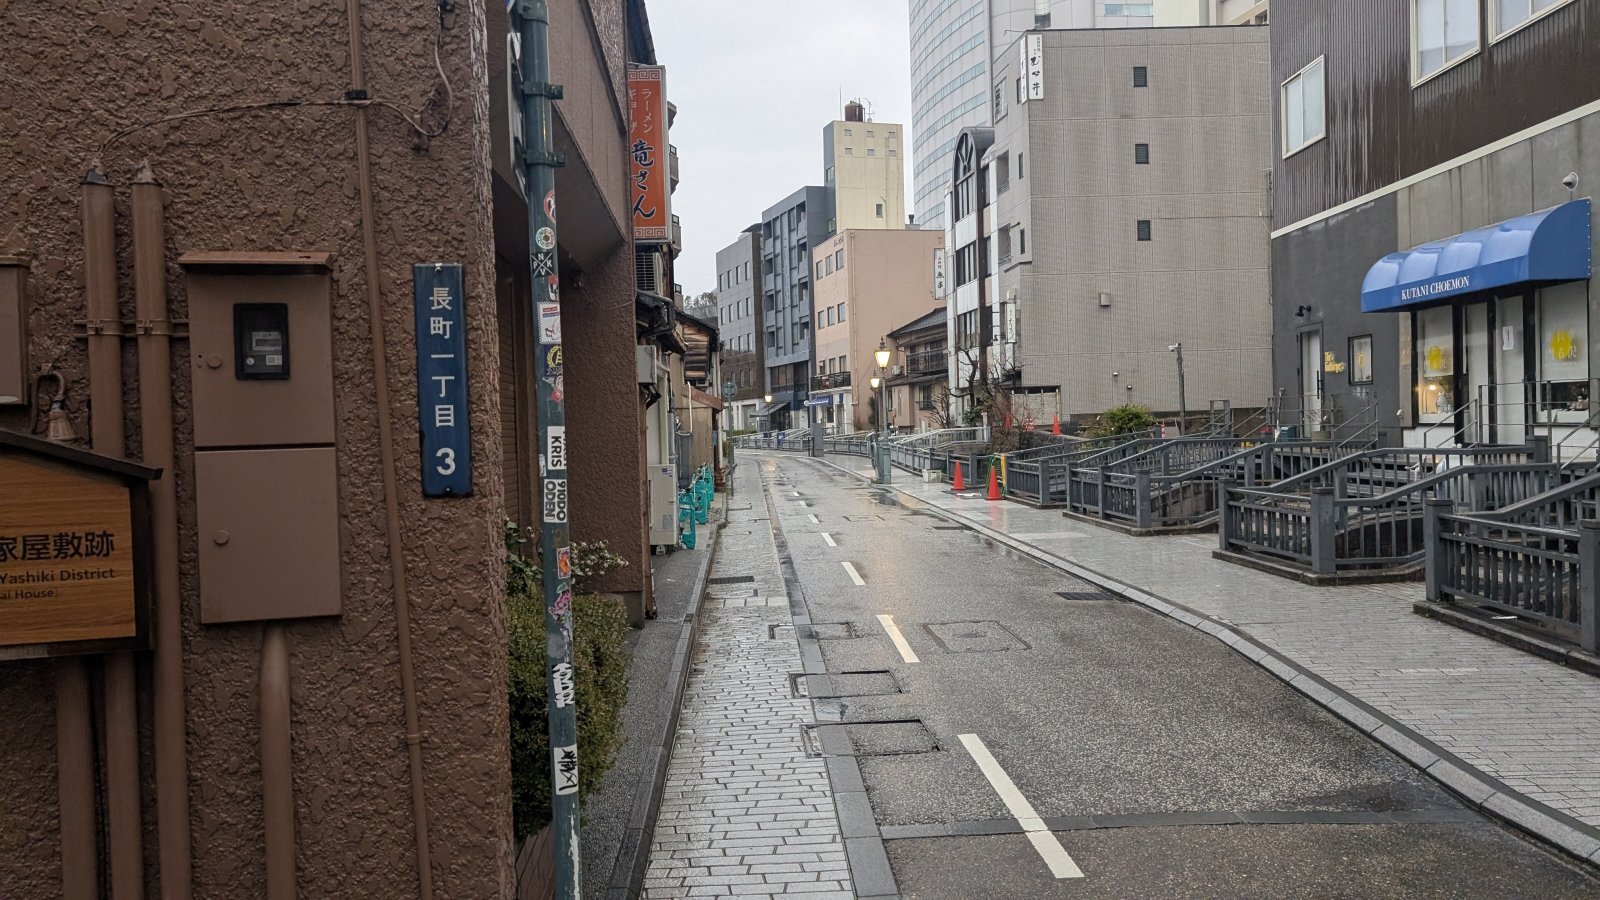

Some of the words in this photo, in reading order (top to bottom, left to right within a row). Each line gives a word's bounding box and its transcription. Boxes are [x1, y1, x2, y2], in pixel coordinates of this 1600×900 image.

[641, 88, 653, 133] ラーメン
[631, 139, 656, 219] 竜さん
[1401, 284, 1429, 300] KUTANI
[1430, 275, 1470, 294] CHOEMON
[429, 287, 455, 427] 長町一丁目
[435, 448, 456, 476] 3
[551, 435, 562, 468] KRIS
[545, 481, 556, 518] ODEN
[556, 481, 566, 521] 910DO
[0, 530, 115, 562] 家屋敷跡
[0, 569, 54, 584] Yashiki
[60, 568, 115, 581] District
[15, 589, 54, 599] House
